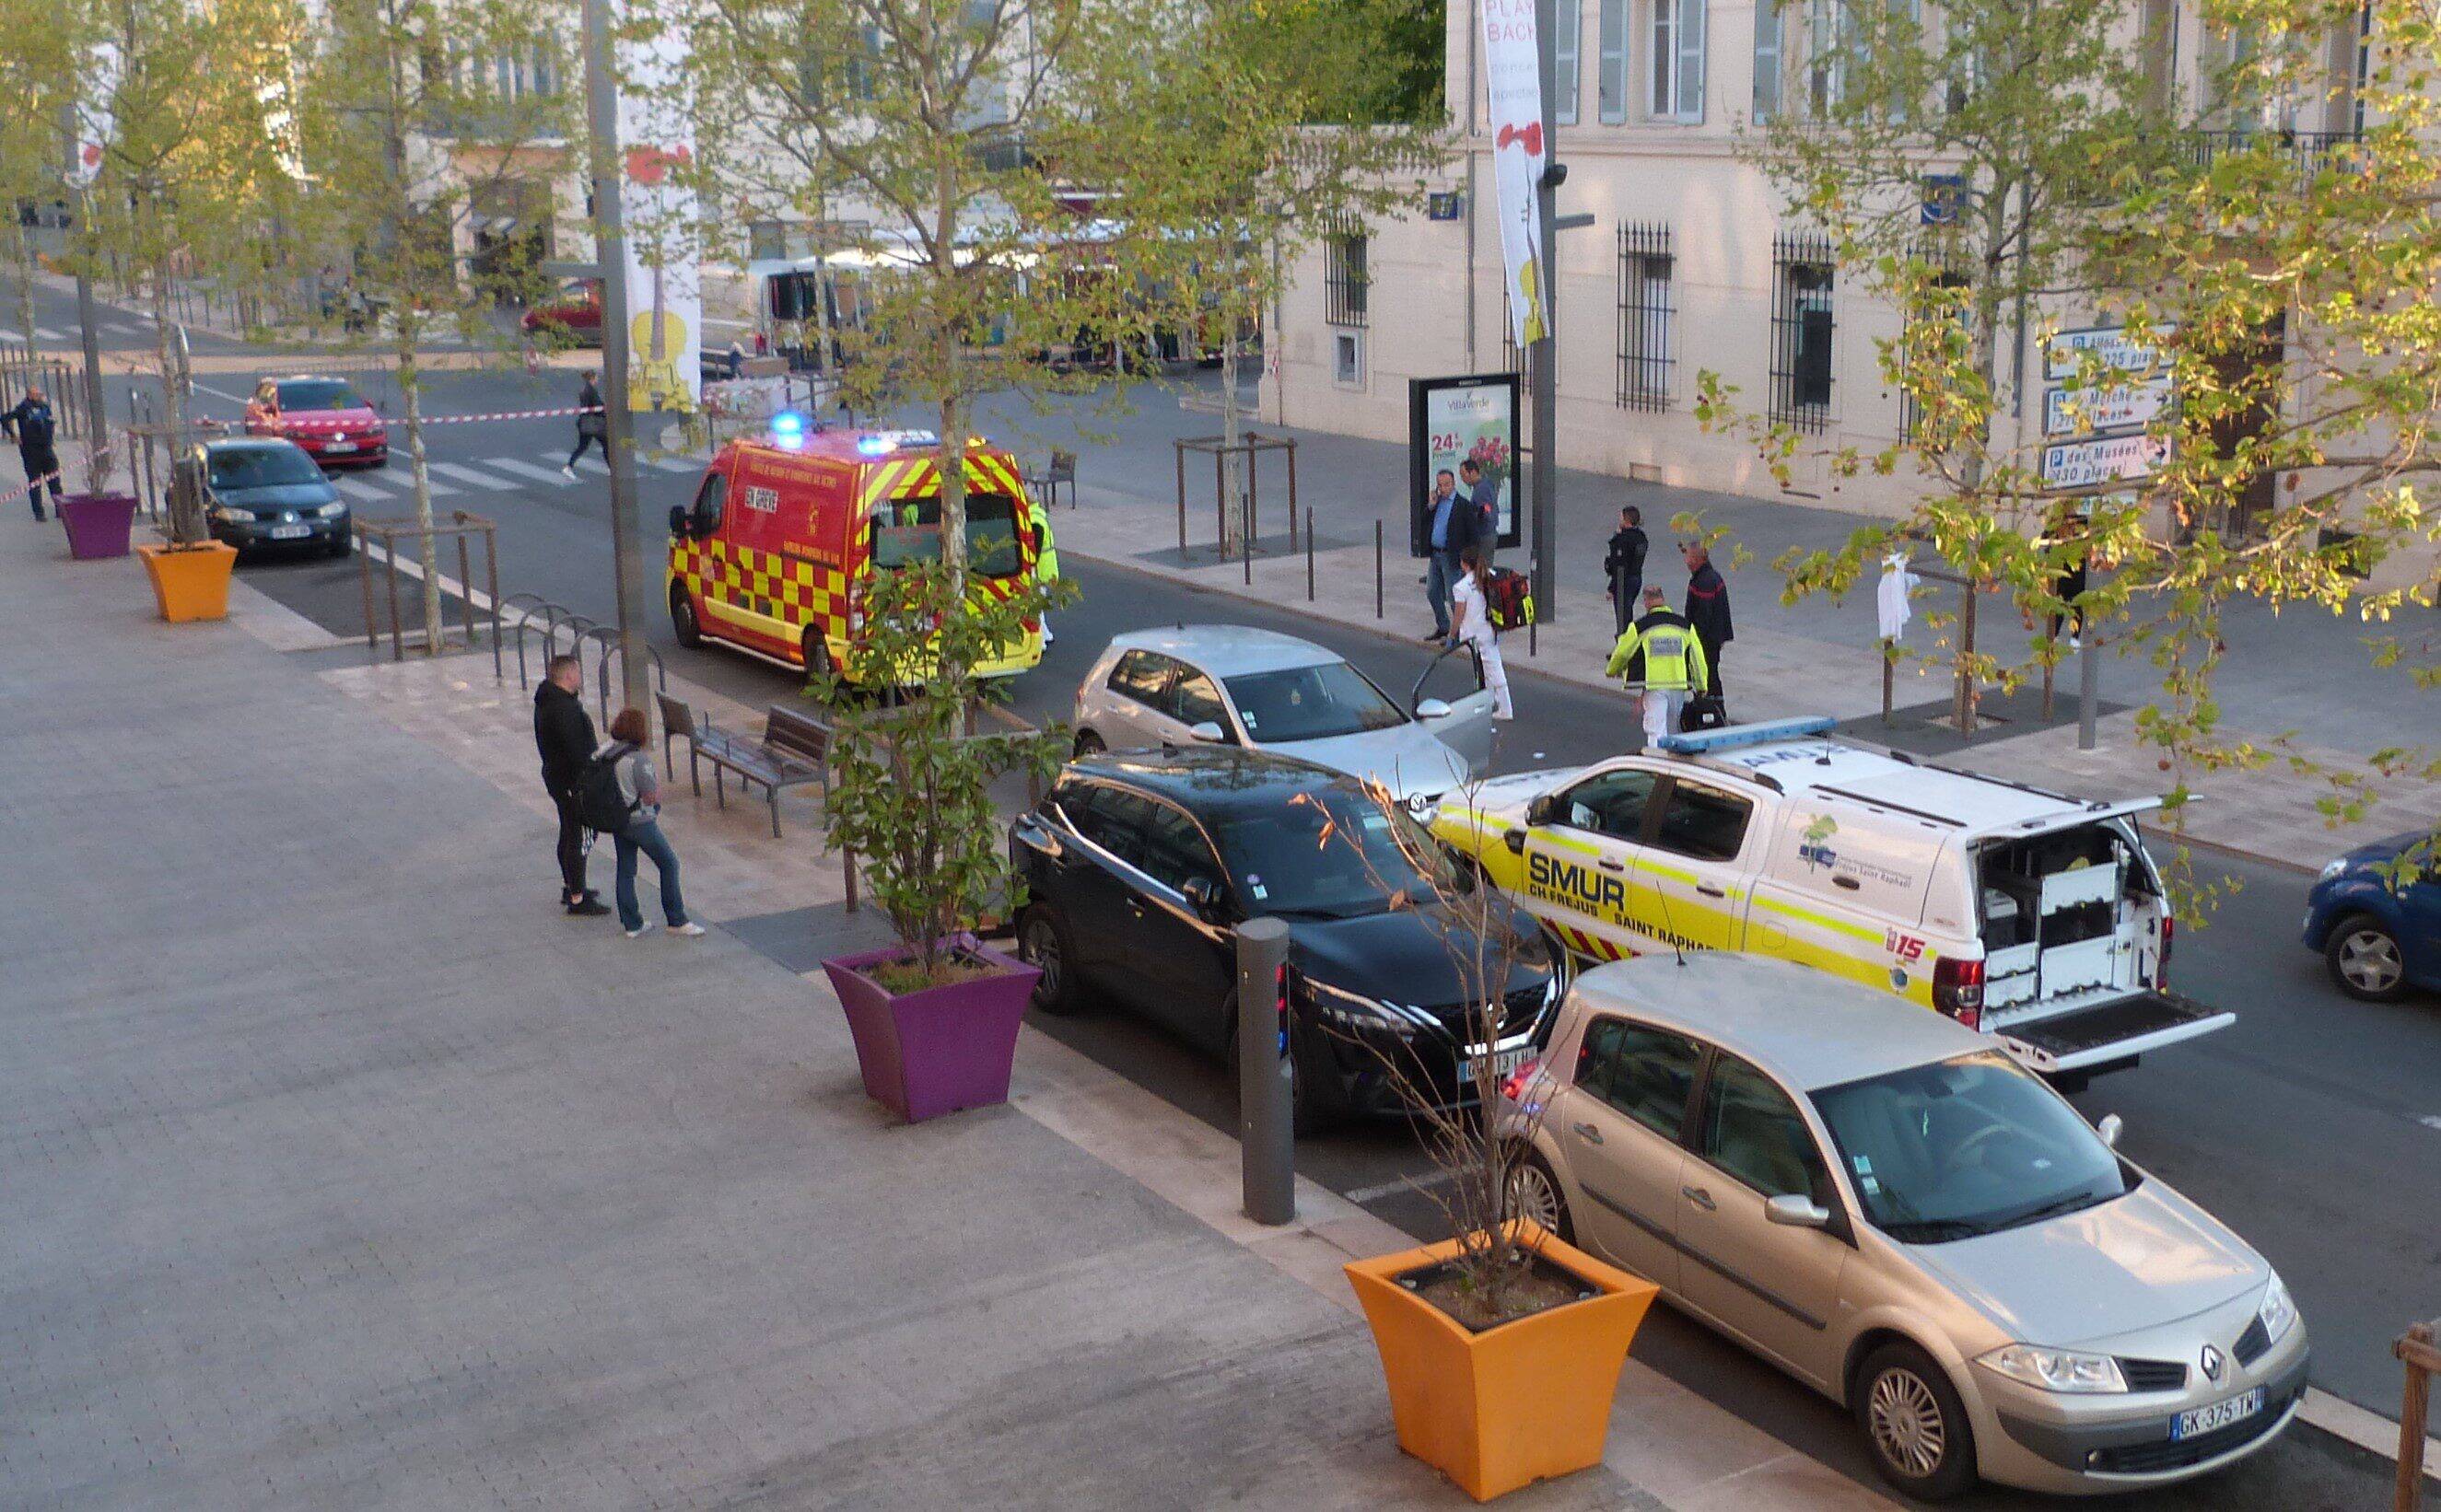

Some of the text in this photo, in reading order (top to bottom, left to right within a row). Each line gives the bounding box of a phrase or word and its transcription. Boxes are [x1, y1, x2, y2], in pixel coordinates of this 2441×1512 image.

[1529, 851, 1625, 912] SMUR
[1530, 883, 1547, 899] CH
[1615, 912, 1655, 937] SAINT
[1896, 934, 1926, 960] 15
